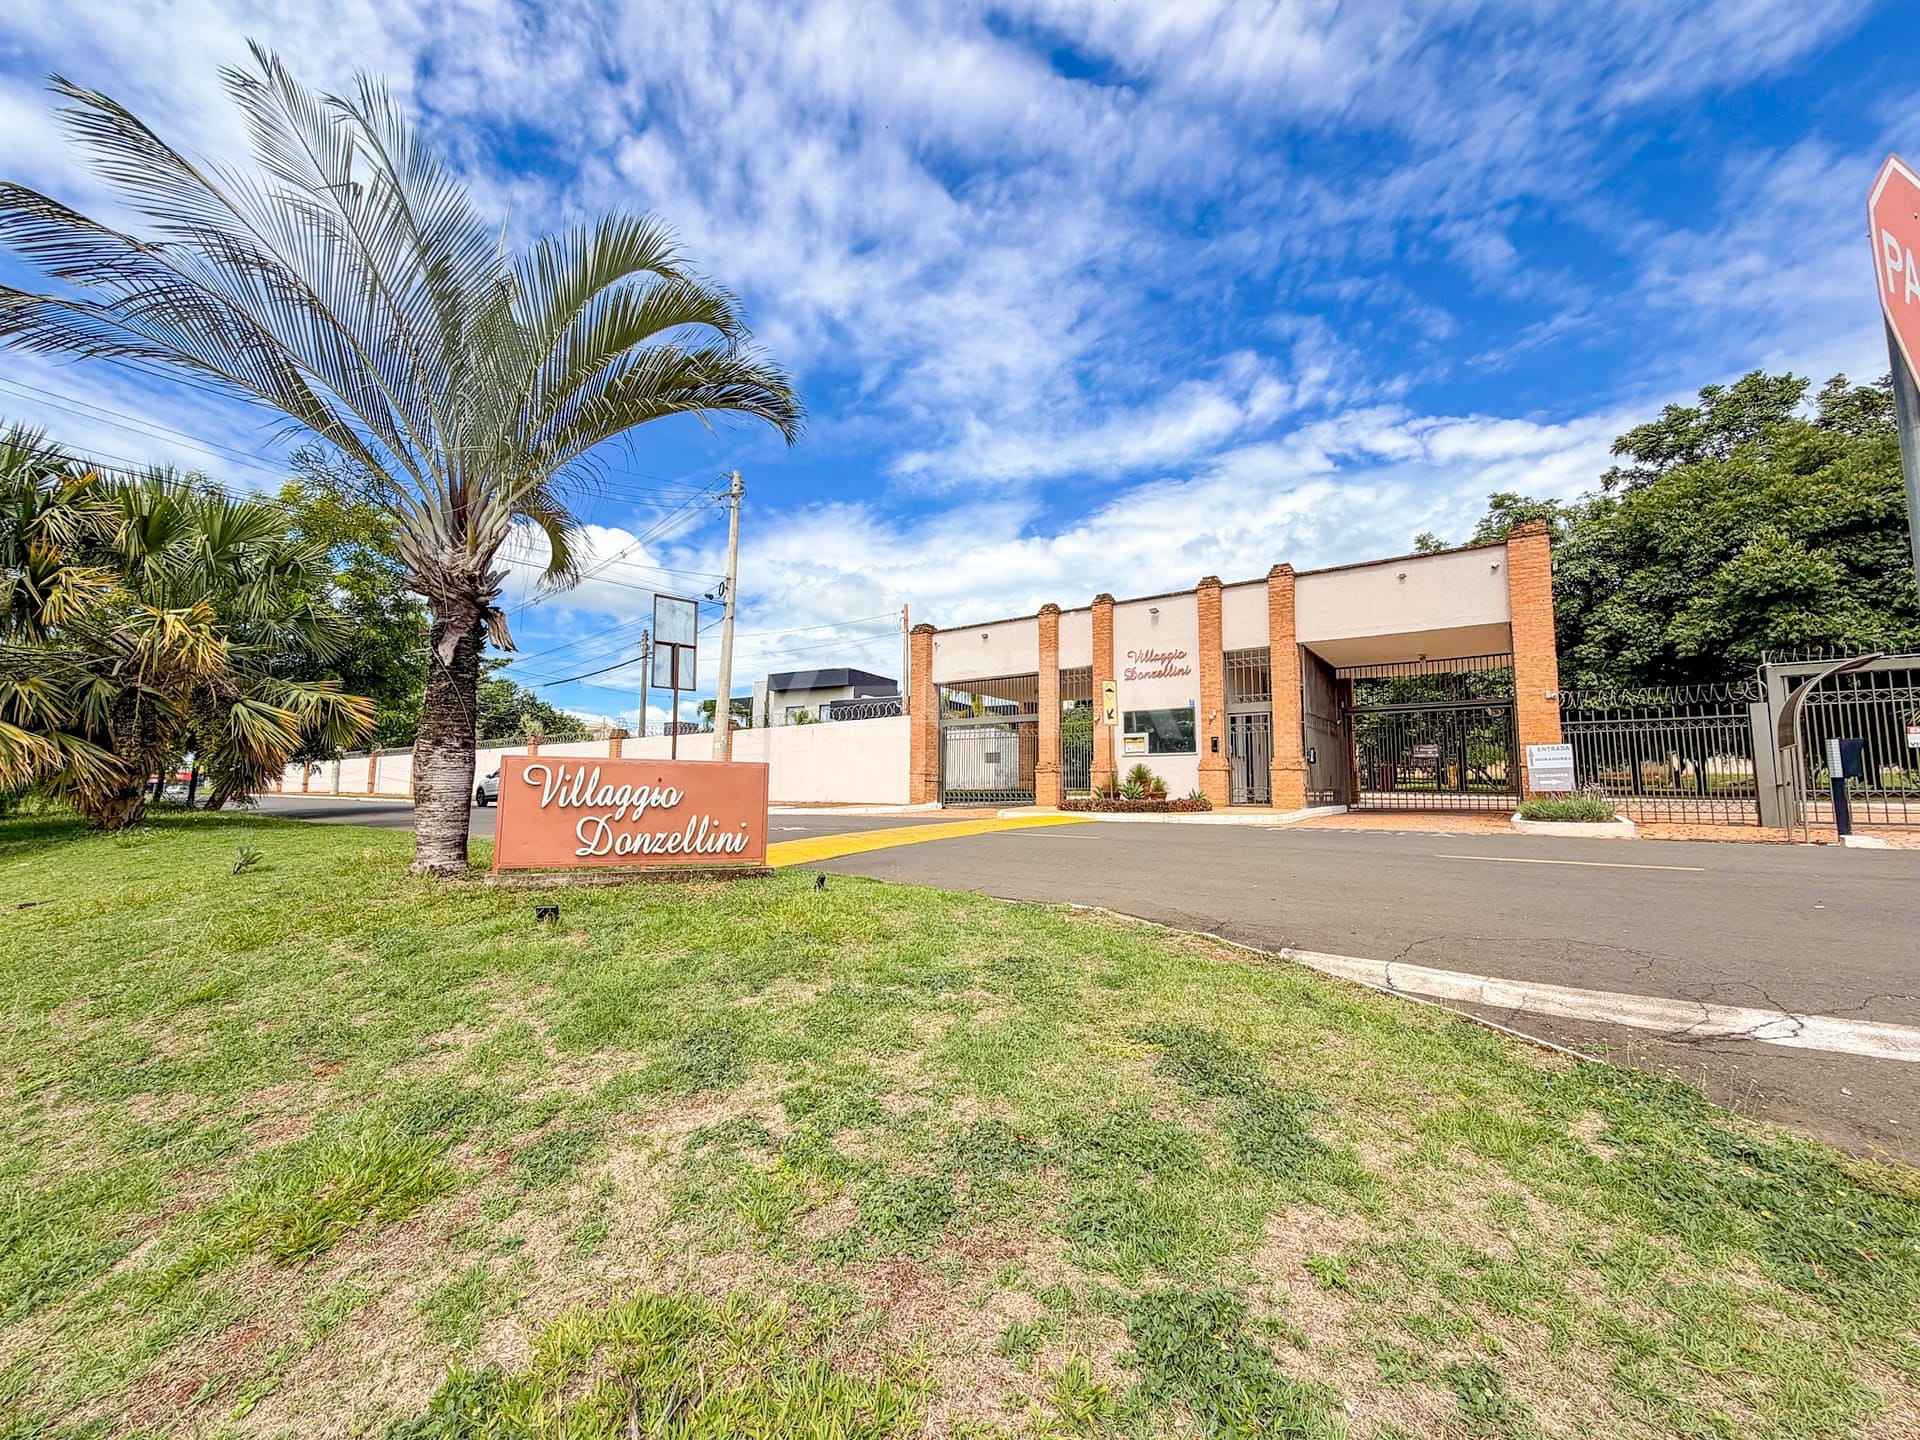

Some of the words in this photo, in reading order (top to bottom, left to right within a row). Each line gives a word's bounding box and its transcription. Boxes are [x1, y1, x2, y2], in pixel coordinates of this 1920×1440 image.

[1127, 648, 1187, 665] Villaggio
[1124, 664, 1192, 681] Donzellini
[523, 764, 684, 821] Villaggio
[574, 813, 749, 857] Donzellini
